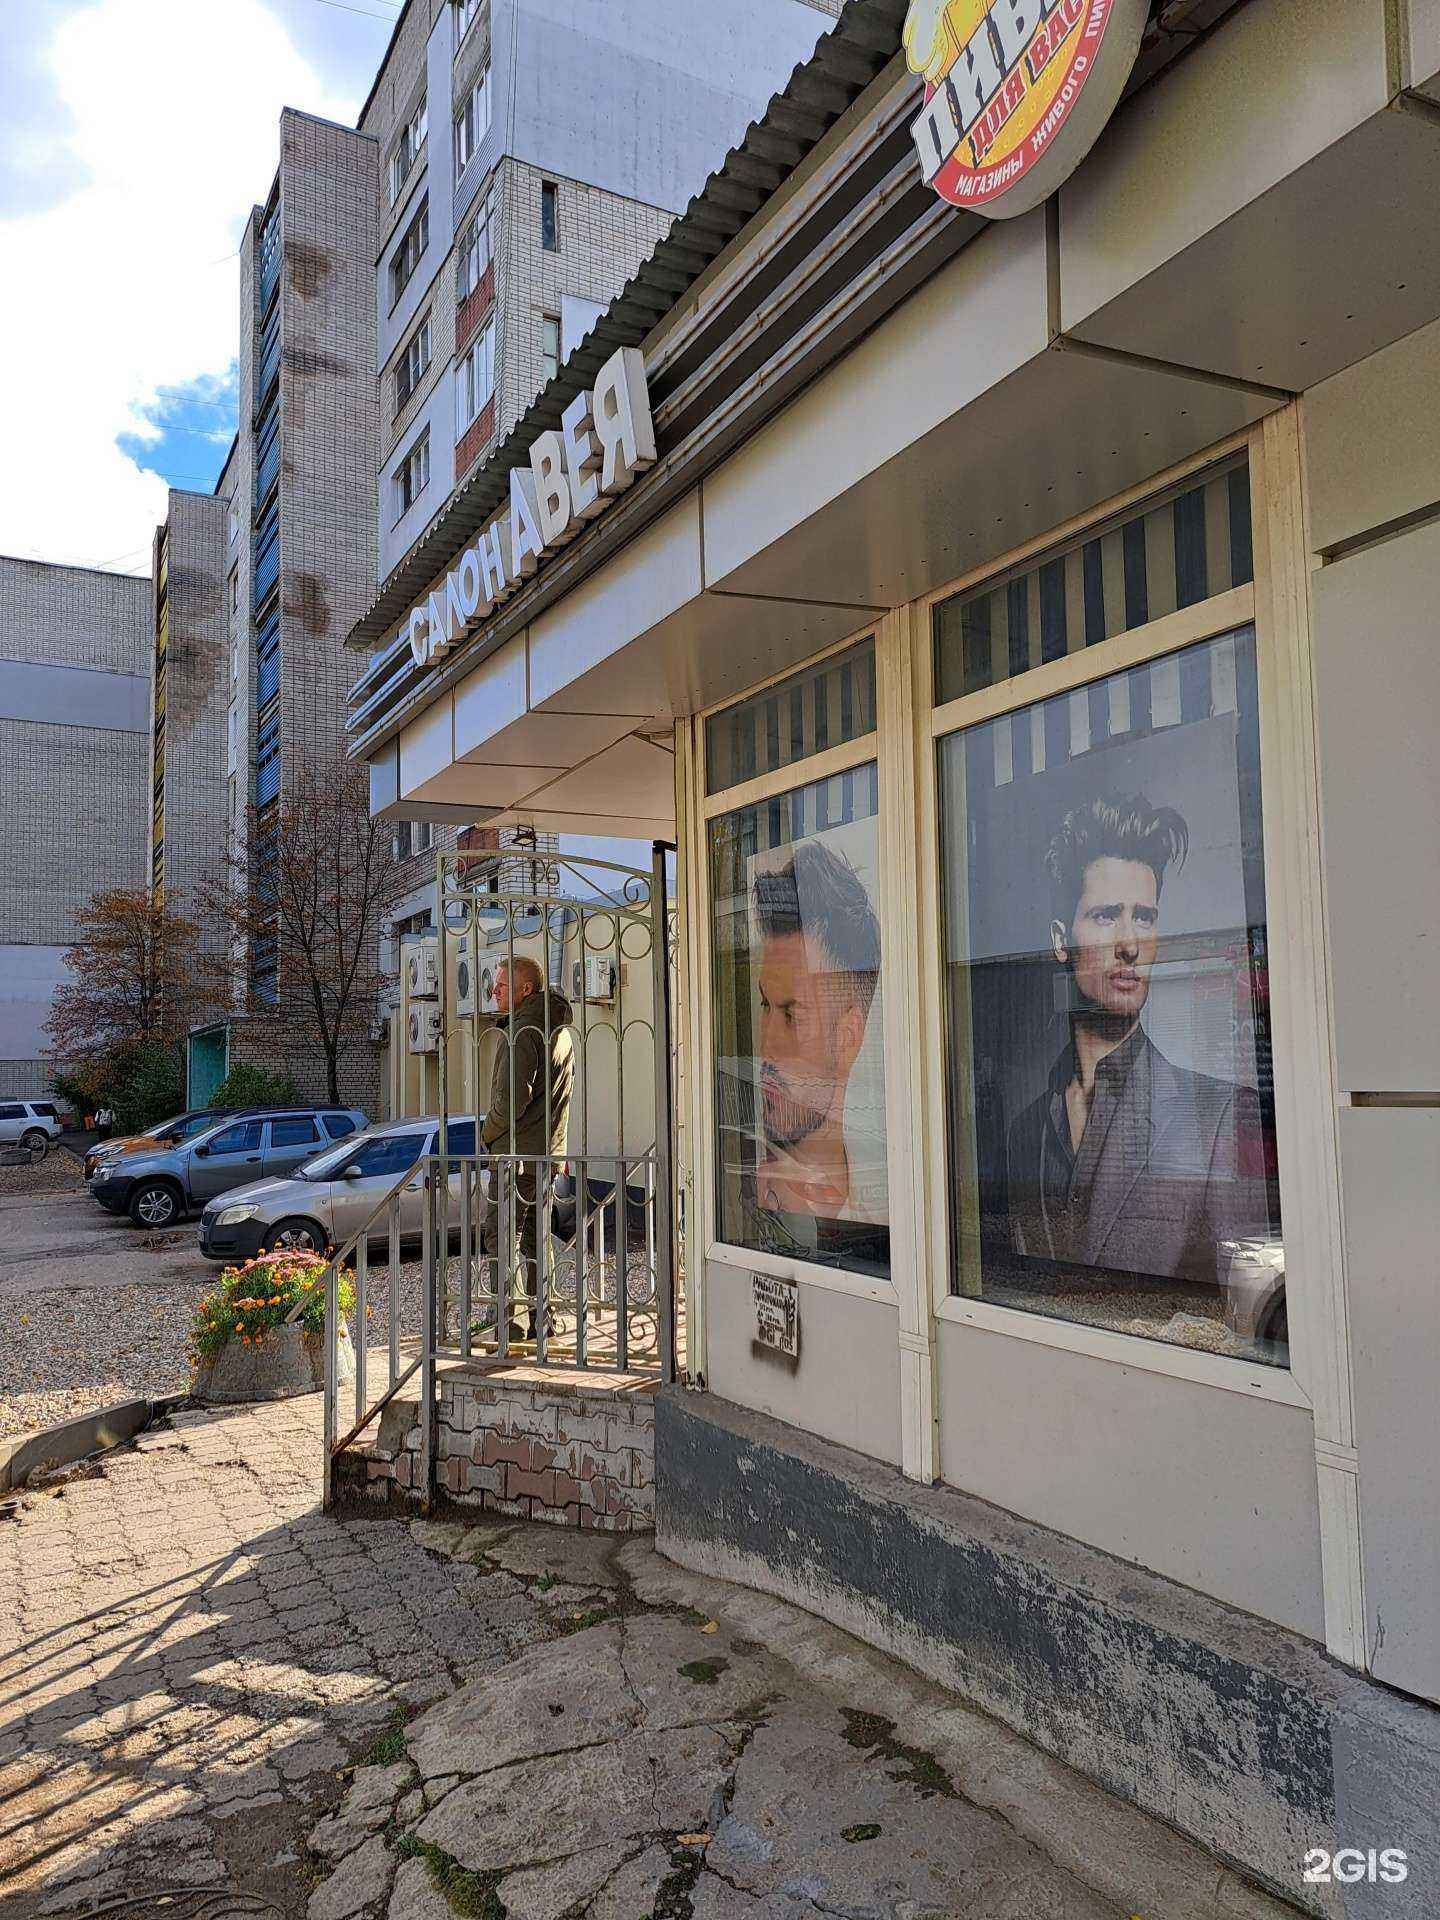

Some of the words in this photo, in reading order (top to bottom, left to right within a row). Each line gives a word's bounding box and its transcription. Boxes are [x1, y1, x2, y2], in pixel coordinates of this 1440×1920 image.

[911, 0, 1060, 186] ПИВ
[955, 150, 1024, 196] МАГАЗИНЫ
[1030, 55, 1088, 153] ЖИВОГО
[969, 66, 1028, 166] ДЛЯ
[409, 520, 508, 667] САЛОН
[509, 347, 653, 579] АВЕЯ
